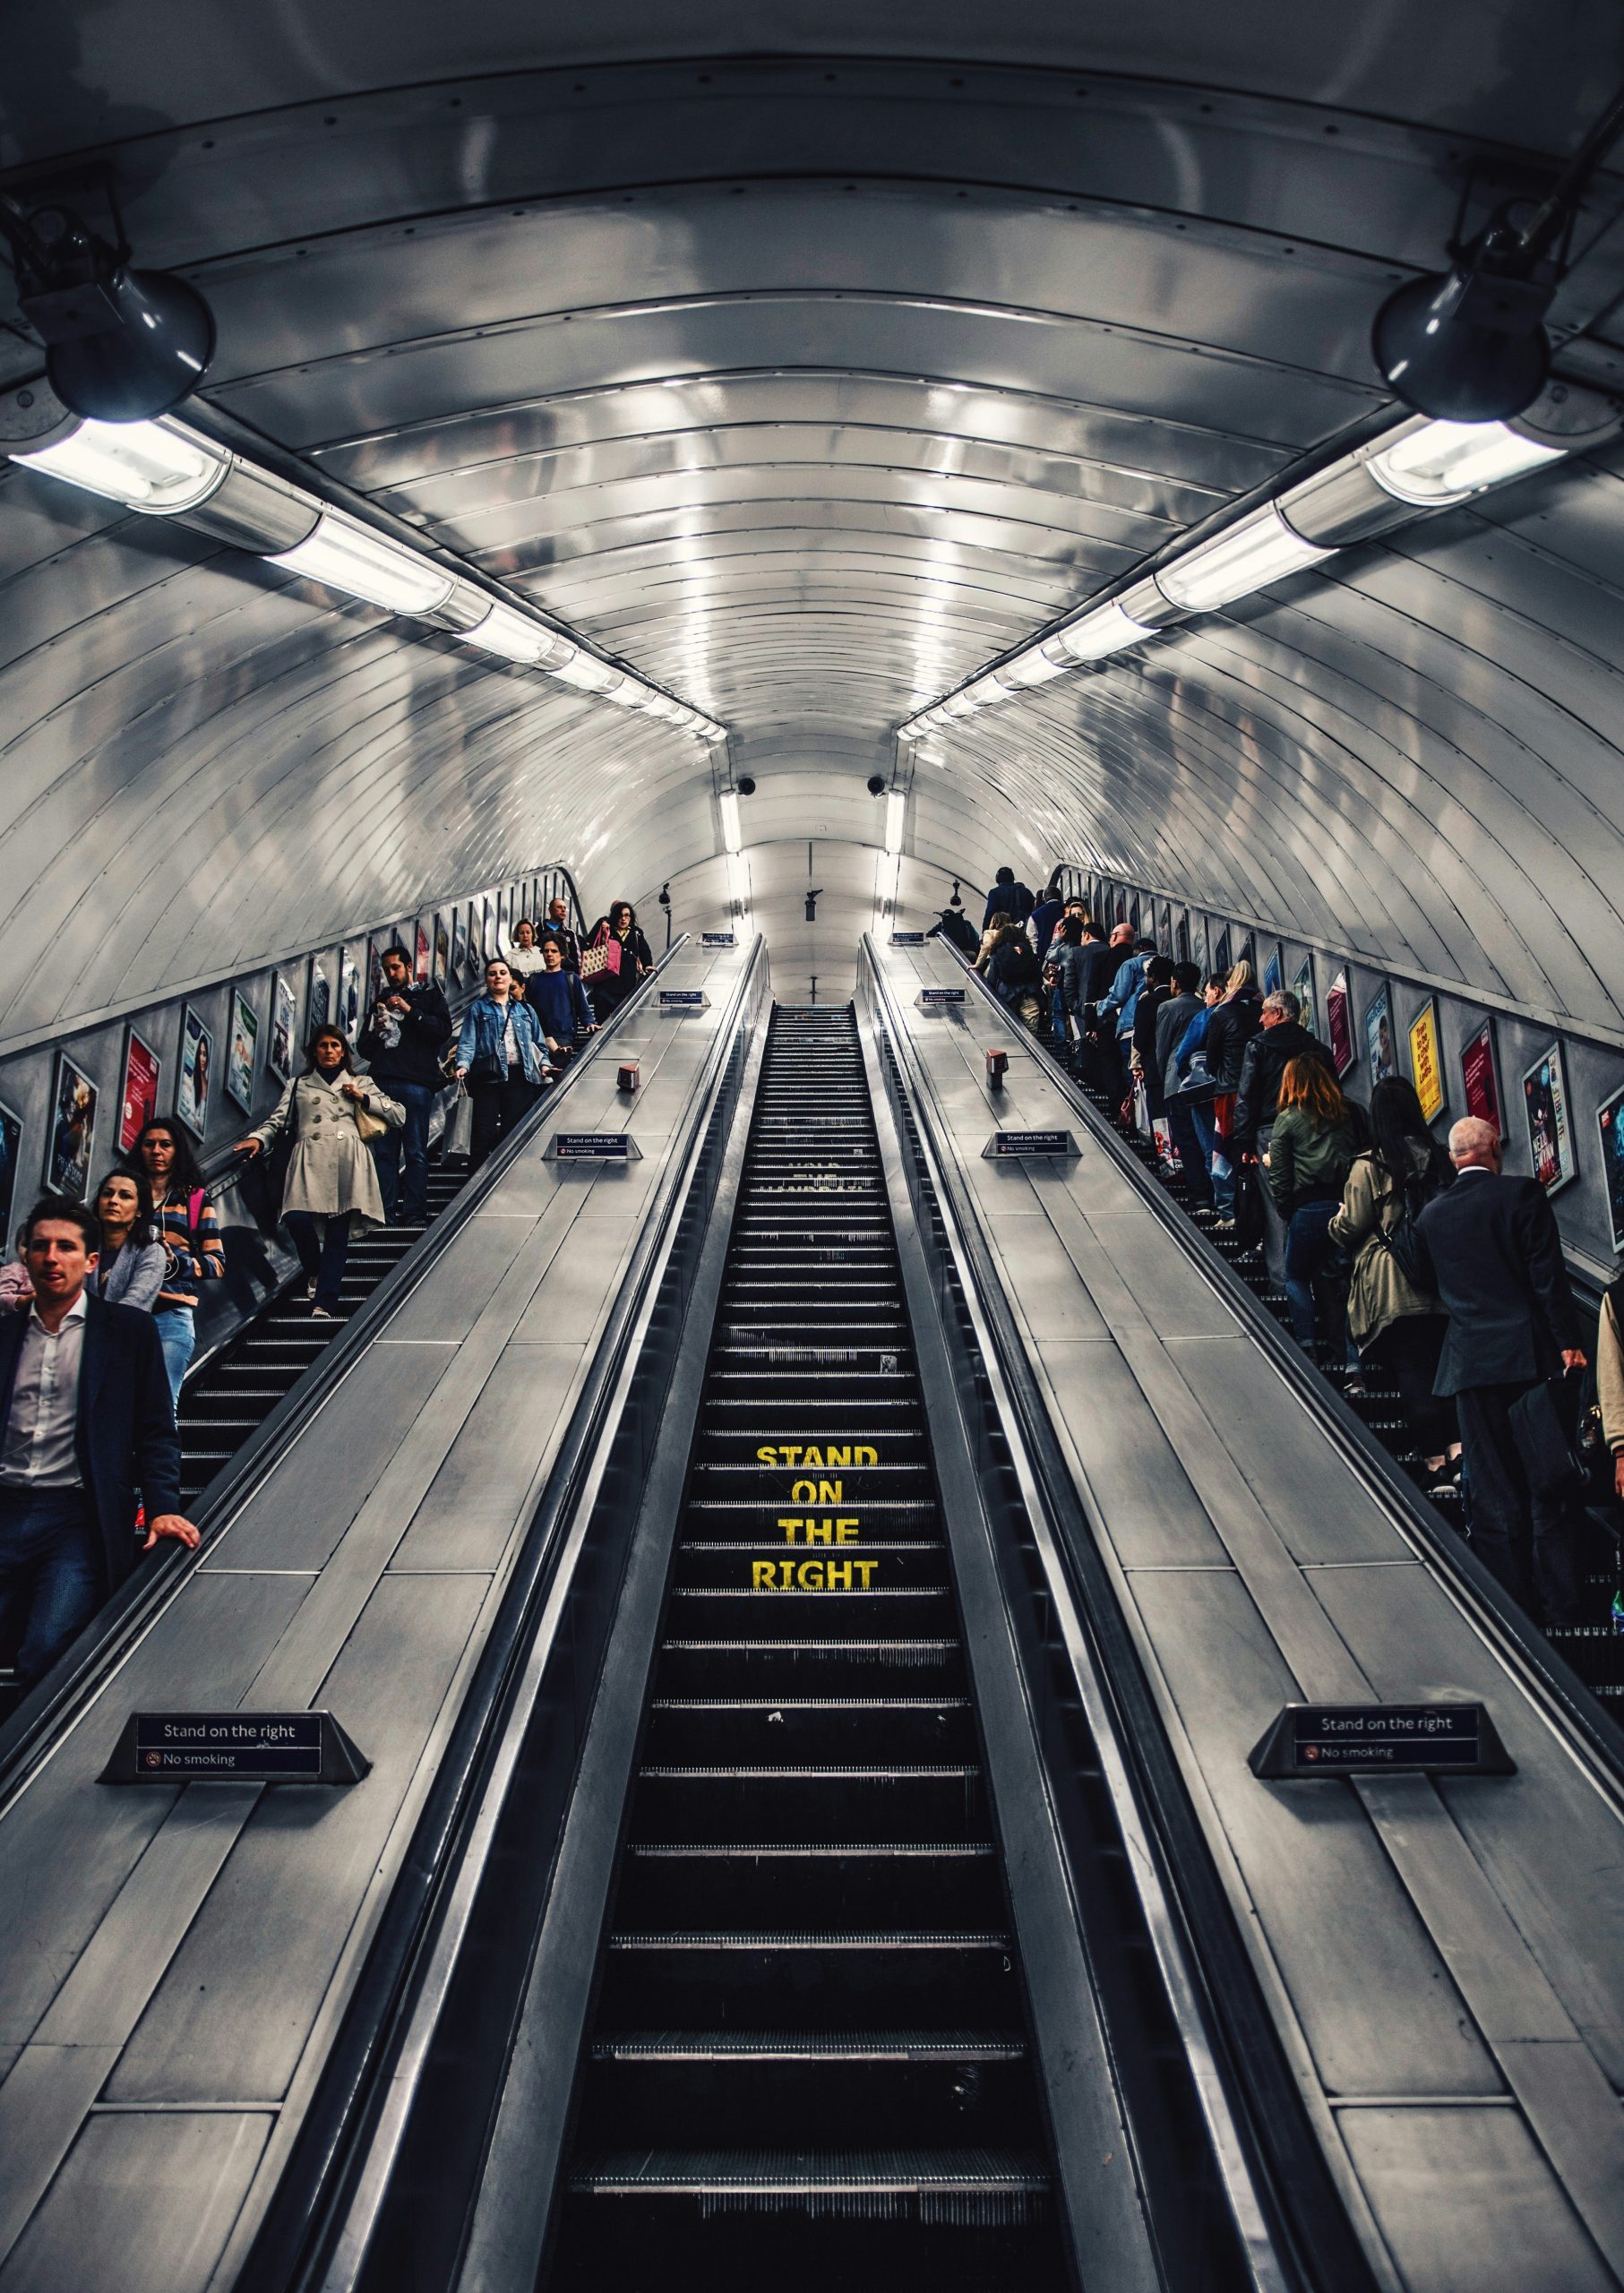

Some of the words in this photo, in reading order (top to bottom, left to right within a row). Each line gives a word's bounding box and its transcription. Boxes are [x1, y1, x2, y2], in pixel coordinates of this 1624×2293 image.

[1416, 1022, 1426, 1038] Train
[1417, 1040, 1422, 1050] to
[1422, 1033, 1427, 1043] be
[1421, 1039, 1430, 1058] chef
[1420, 1055, 1429, 1070] with
[756, 1446, 878, 1466] STAND
[791, 1480, 843, 1504] ON
[778, 1518, 859, 1544] THE
[752, 1560, 879, 1590] RIGHT
[164, 1724, 205, 1738] Stand
[211, 1727, 228, 1737] on
[232, 1725, 256, 1738] the
[260, 1724, 296, 1740] right
[1321, 1718, 1363, 1731] Stand
[1367, 1721, 1385, 1730] on
[1389, 1718, 1413, 1730] the
[1418, 1717, 1453, 1732] right
[163, 1754, 181, 1765] No
[185, 1753, 235, 1766] smoking
[1321, 1748, 1339, 1757] No
[1343, 1747, 1394, 1759] smoking
